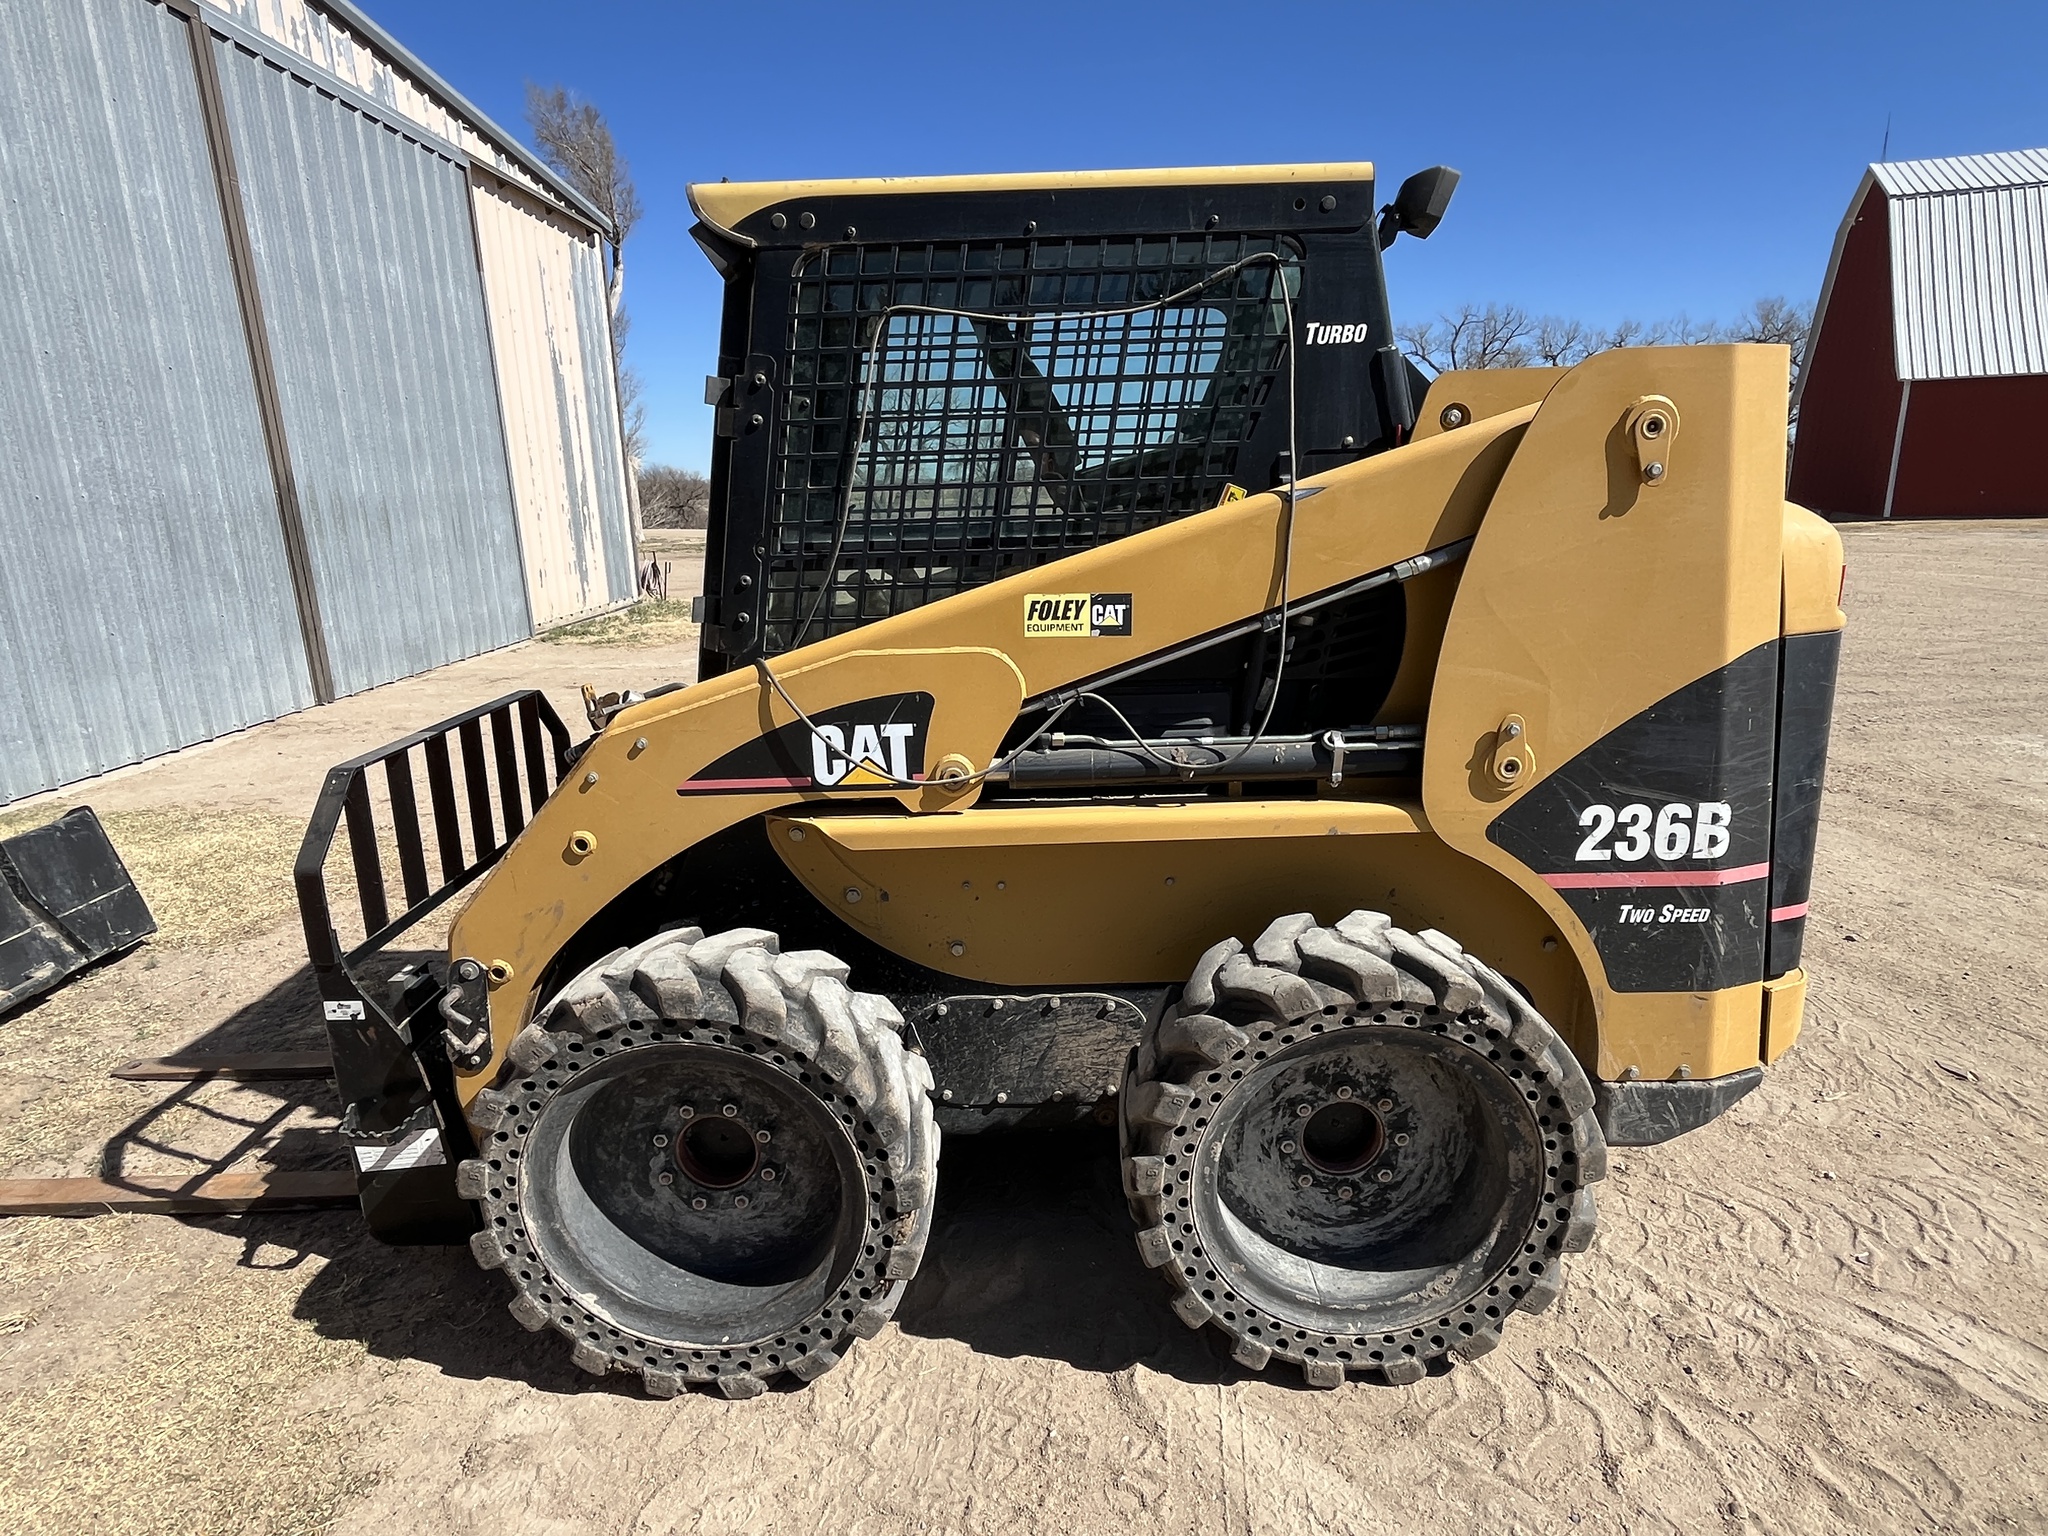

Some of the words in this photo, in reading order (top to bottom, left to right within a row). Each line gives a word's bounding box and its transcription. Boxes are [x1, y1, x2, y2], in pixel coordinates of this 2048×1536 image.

[1306, 322, 1368, 345] TURBO
[1027, 600, 1087, 621] FOLEY
[1092, 604, 1127, 626] CAT
[1026, 623, 1084, 632] EQUIPMENT
[811, 723, 914, 786] CAT
[1575, 802, 1732, 861] 236B
[1619, 904, 1655, 923] TWO
[1659, 904, 1711, 923] SPEED
